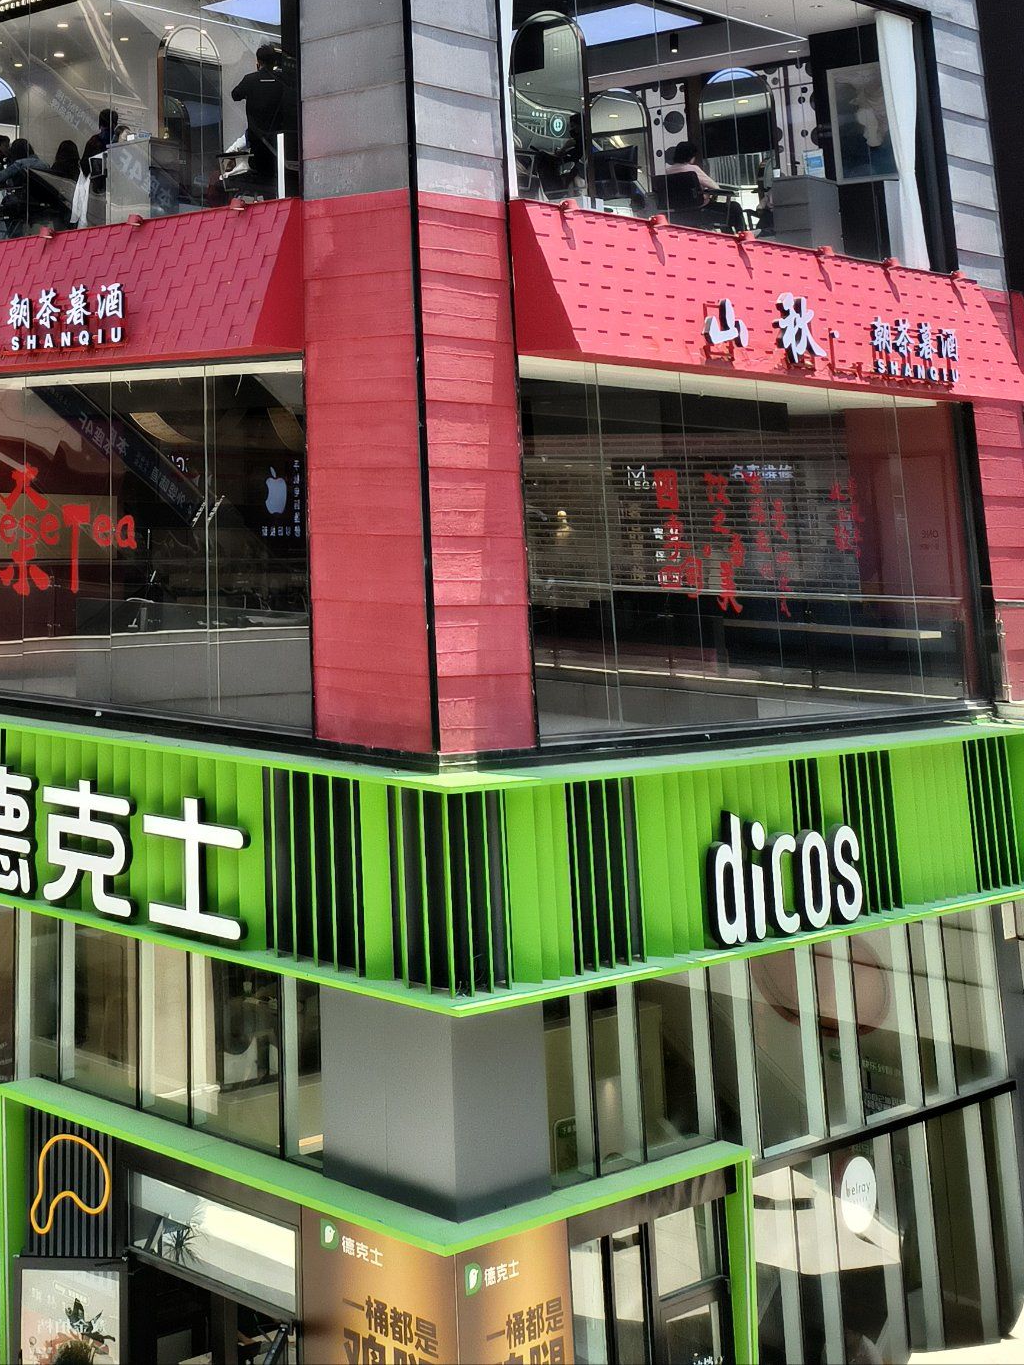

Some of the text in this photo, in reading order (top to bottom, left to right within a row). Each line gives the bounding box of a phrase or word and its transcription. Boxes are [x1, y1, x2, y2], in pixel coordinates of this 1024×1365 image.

[7, 283, 124, 330] 朝茶暮酒
[10, 326, 123, 351] SHANQIU
[870, 316, 959, 362] 朝茶暮酒
[875, 359, 960, 383] SHANQIU
[62, 504, 137, 593] Tea
[710, 811, 864, 946] dicos
[342, 1235, 384, 1268] 德克士
[484, 1259, 520, 1287] 德克士
[343, 1295, 439, 1359] 一桶都是
[486, 1296, 564, 1351] 一桶都是
